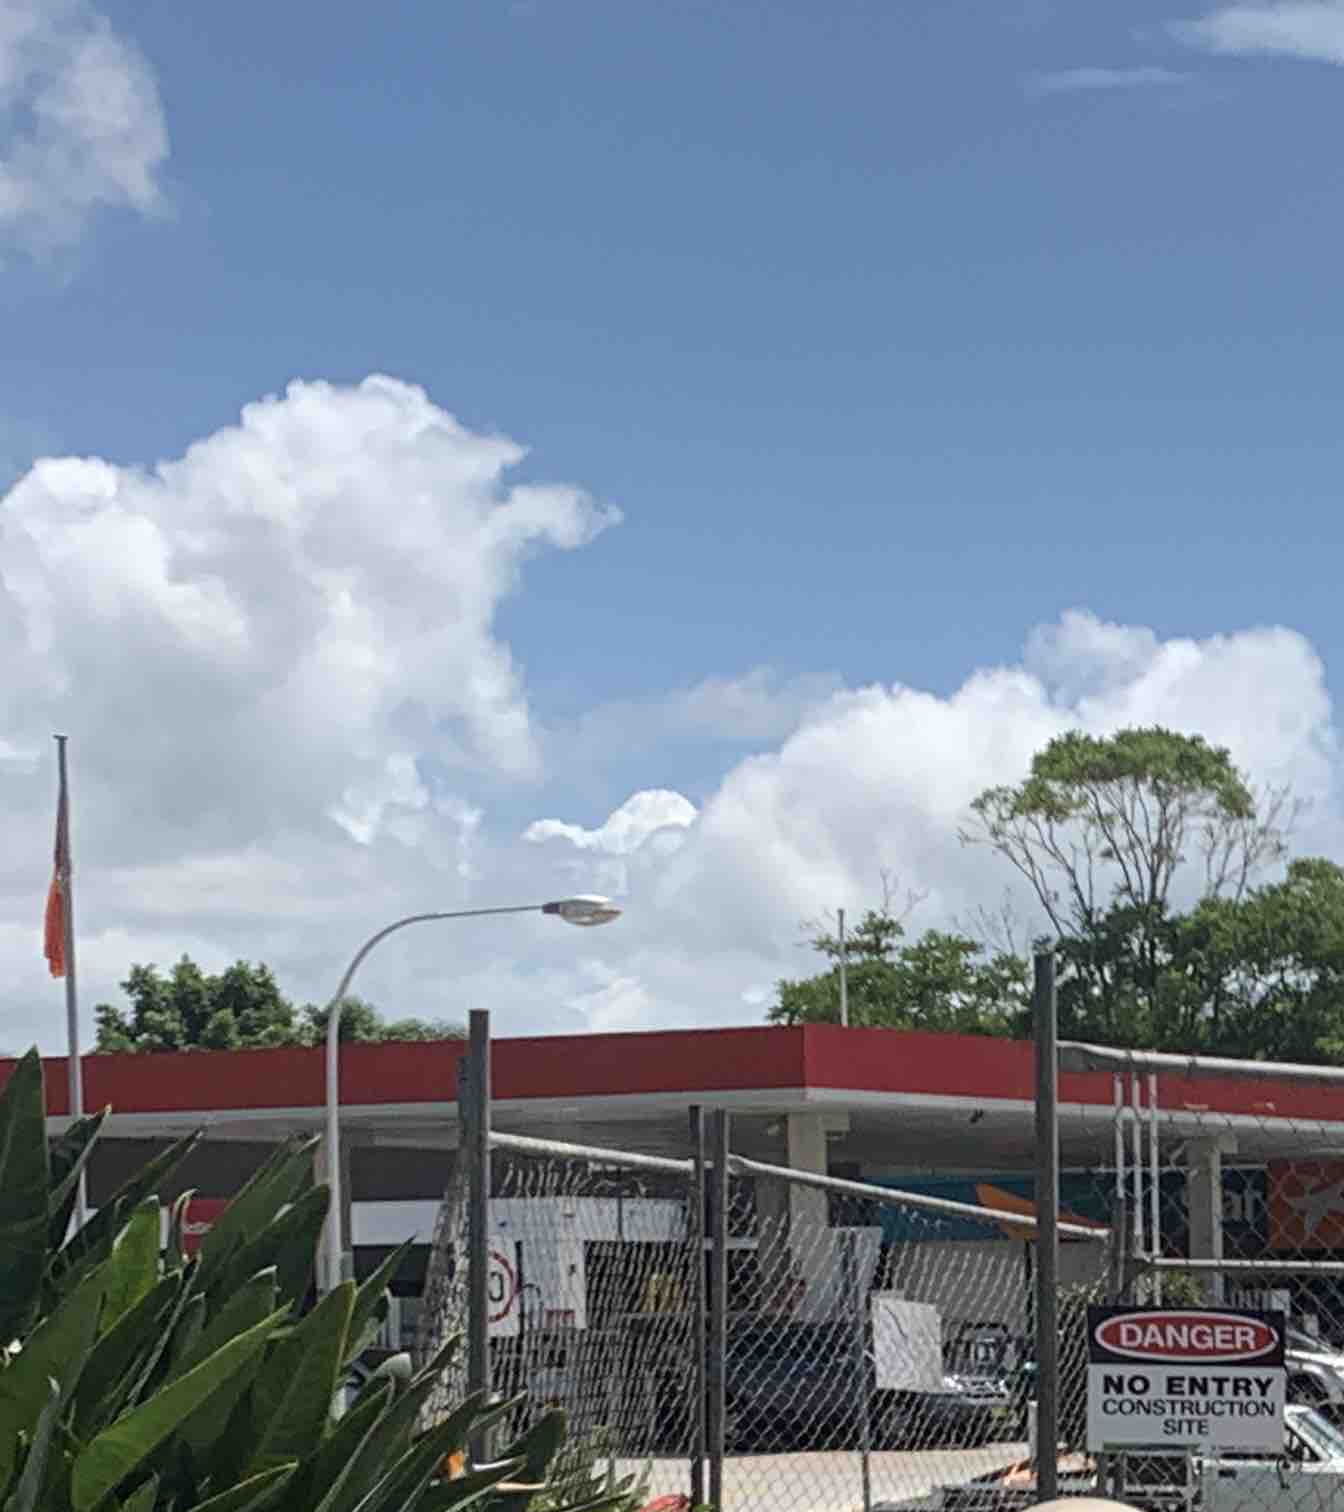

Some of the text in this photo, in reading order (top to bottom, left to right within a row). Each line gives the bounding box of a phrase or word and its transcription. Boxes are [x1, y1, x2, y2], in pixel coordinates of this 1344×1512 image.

[1119, 1323, 1257, 1350] DANGER
[1103, 1374, 1274, 1397] NO ENTRY
[1102, 1399, 1275, 1417] CONSTRUCTION
[1163, 1418, 1210, 1436] SITE
